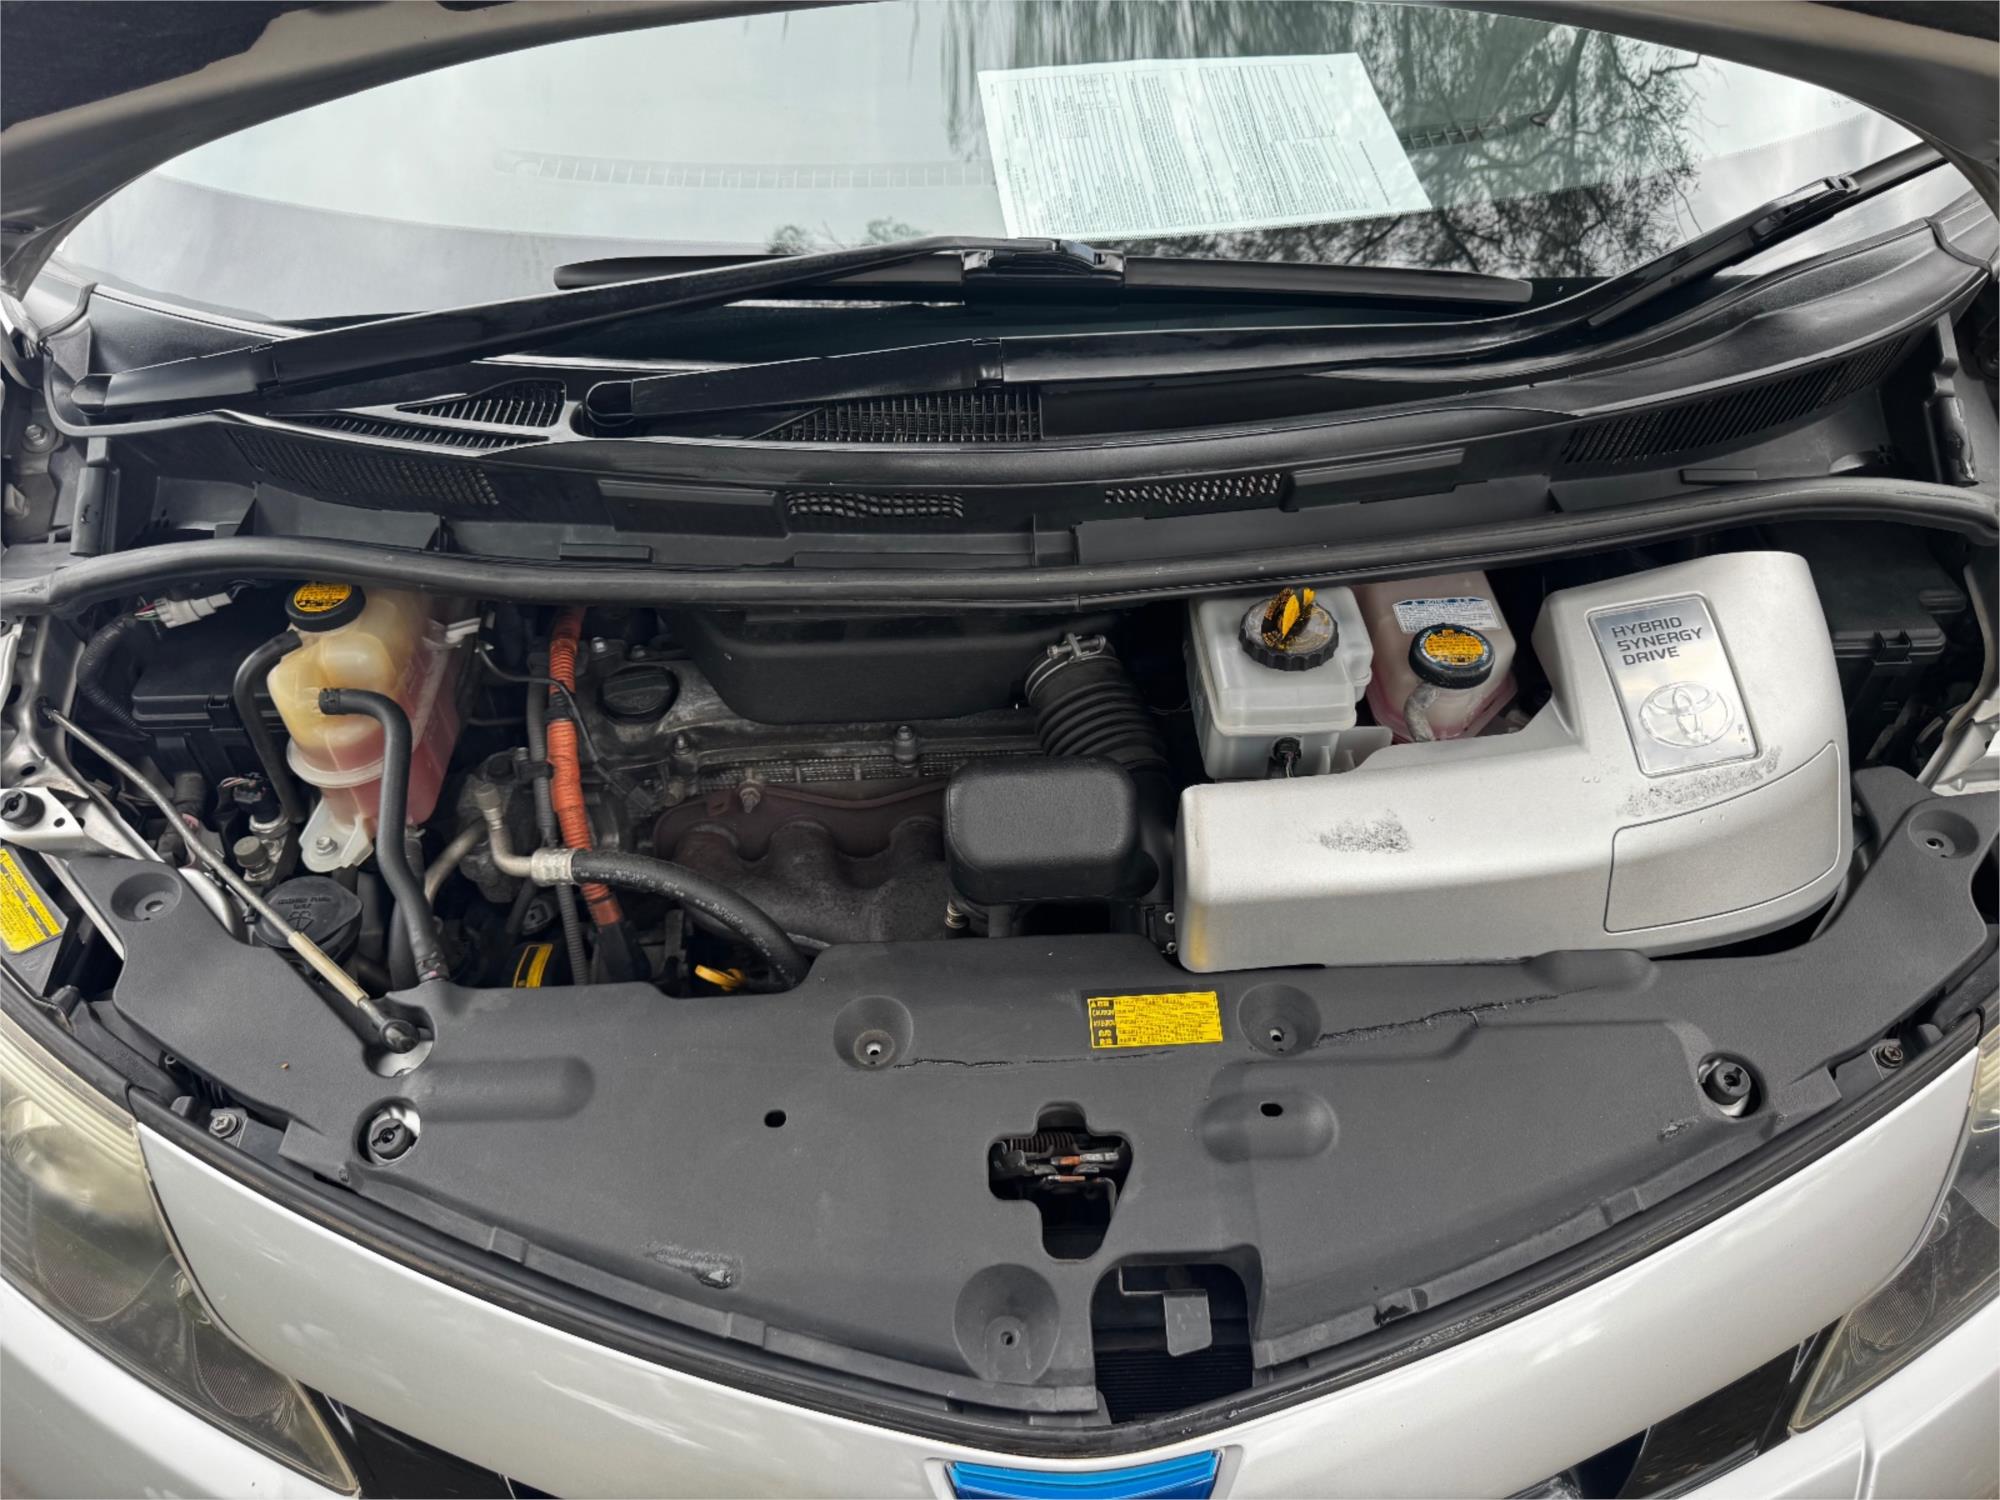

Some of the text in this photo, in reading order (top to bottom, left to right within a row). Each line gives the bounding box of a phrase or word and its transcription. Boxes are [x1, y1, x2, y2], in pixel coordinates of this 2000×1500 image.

[1611, 616, 1682, 638] HYBRID
[1617, 627, 1702, 652] SYNERGY
[1622, 646, 1680, 666] DRIVE
